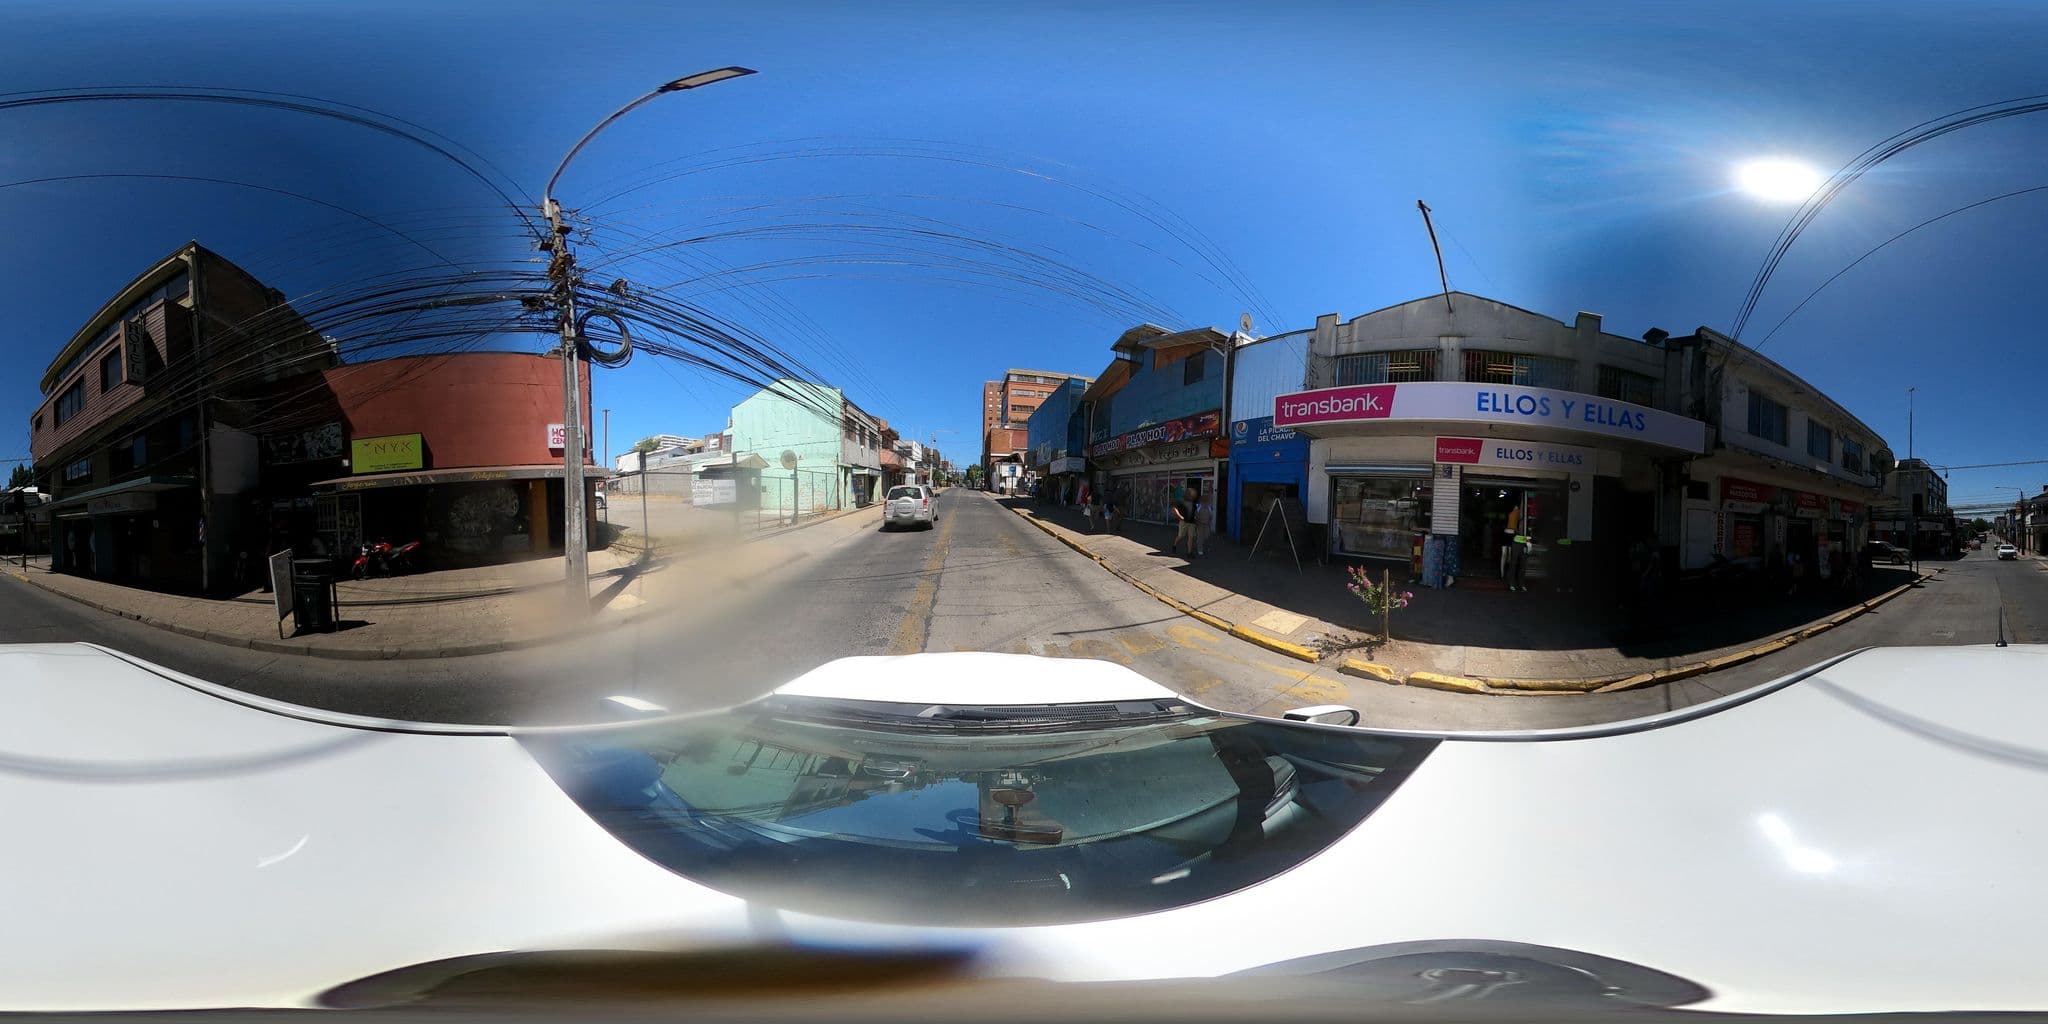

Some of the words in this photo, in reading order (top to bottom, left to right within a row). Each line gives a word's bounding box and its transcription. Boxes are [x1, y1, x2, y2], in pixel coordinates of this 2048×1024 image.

[1477, 392, 1550, 417] ELLOS
[1562, 399, 1575, 419] Y
[1584, 403, 1645, 431] ELLAS
[1147, 427, 1167, 442] HOT
[1270, 433, 1295, 441] CHAVO
[1496, 447, 1533, 461] ELLOS
[1538, 451, 1544, 460] Y
[1548, 451, 1582, 465] ELLAS
